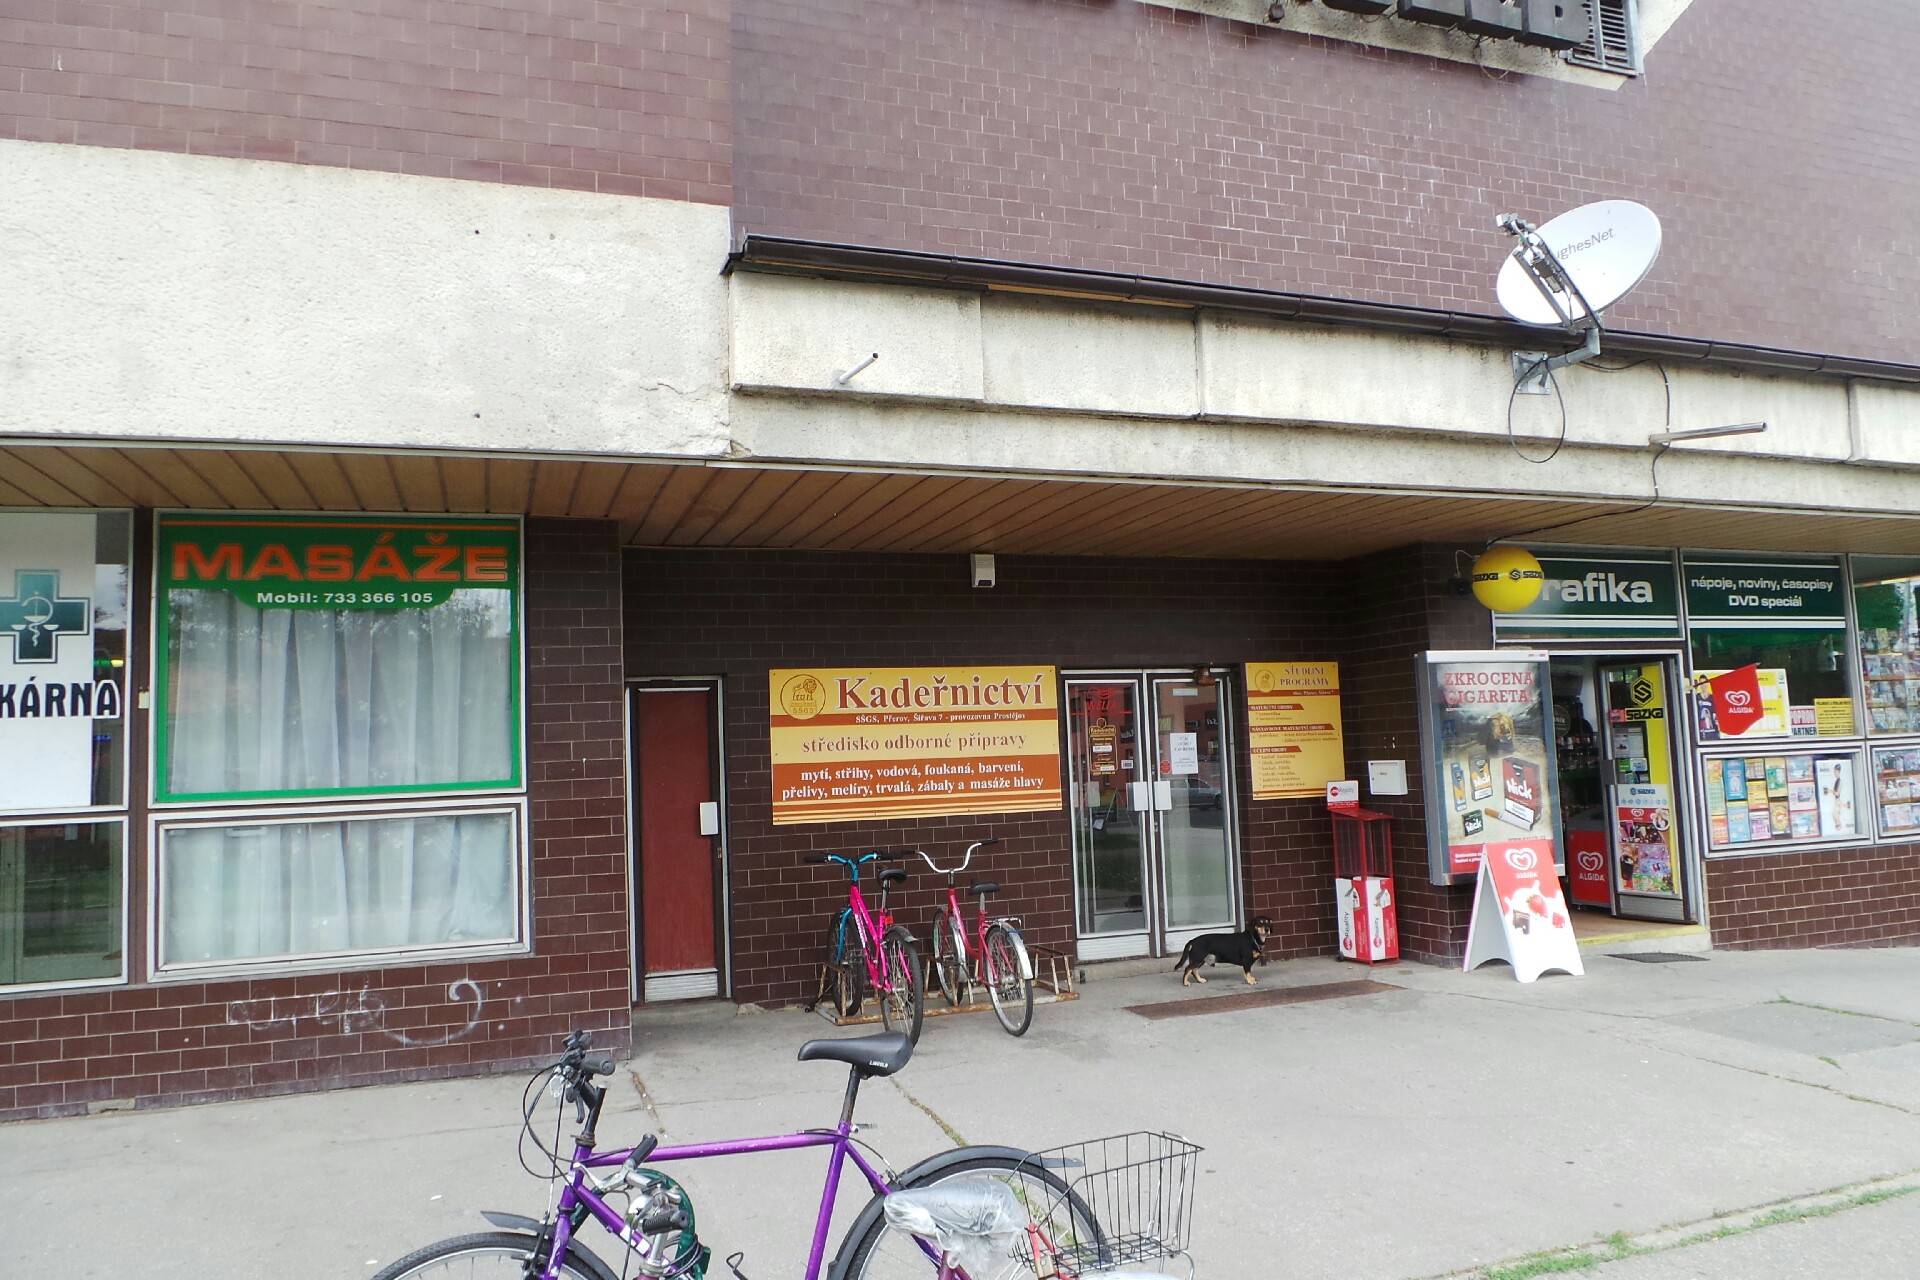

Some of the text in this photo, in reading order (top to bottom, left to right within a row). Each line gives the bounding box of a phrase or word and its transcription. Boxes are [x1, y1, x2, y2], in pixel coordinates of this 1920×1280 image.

[171, 532, 508, 581] MASÁŽE
[1542, 572, 1654, 603] rafika
[1691, 576, 1833, 592] nápoje, noviny, časopisy
[257, 592, 433, 604] Mobil: 733 366 105
[1728, 594, 1803, 608] DVD speciál
[1445, 669, 1535, 685] ZKROCENÁ
[0, 676, 118, 718] KÁRNA
[835, 674, 1045, 709] Kadeřnictví
[938, 713, 943, 721] 7
[950, 713, 991, 722] provozovna
[1792, 726, 1817, 736] ARTNER
[803, 732, 1027, 753] středisko odborné přípravy
[801, 761, 1024, 782] mytí, střihy, vodová, foukaná, barvení,
[782, 775, 1044, 801] přelivy, melíry, trvalá, zábaly a masáže hlavy
[1506, 777, 1533, 800] Nick
[1579, 873, 1606, 881] ALGIDA
